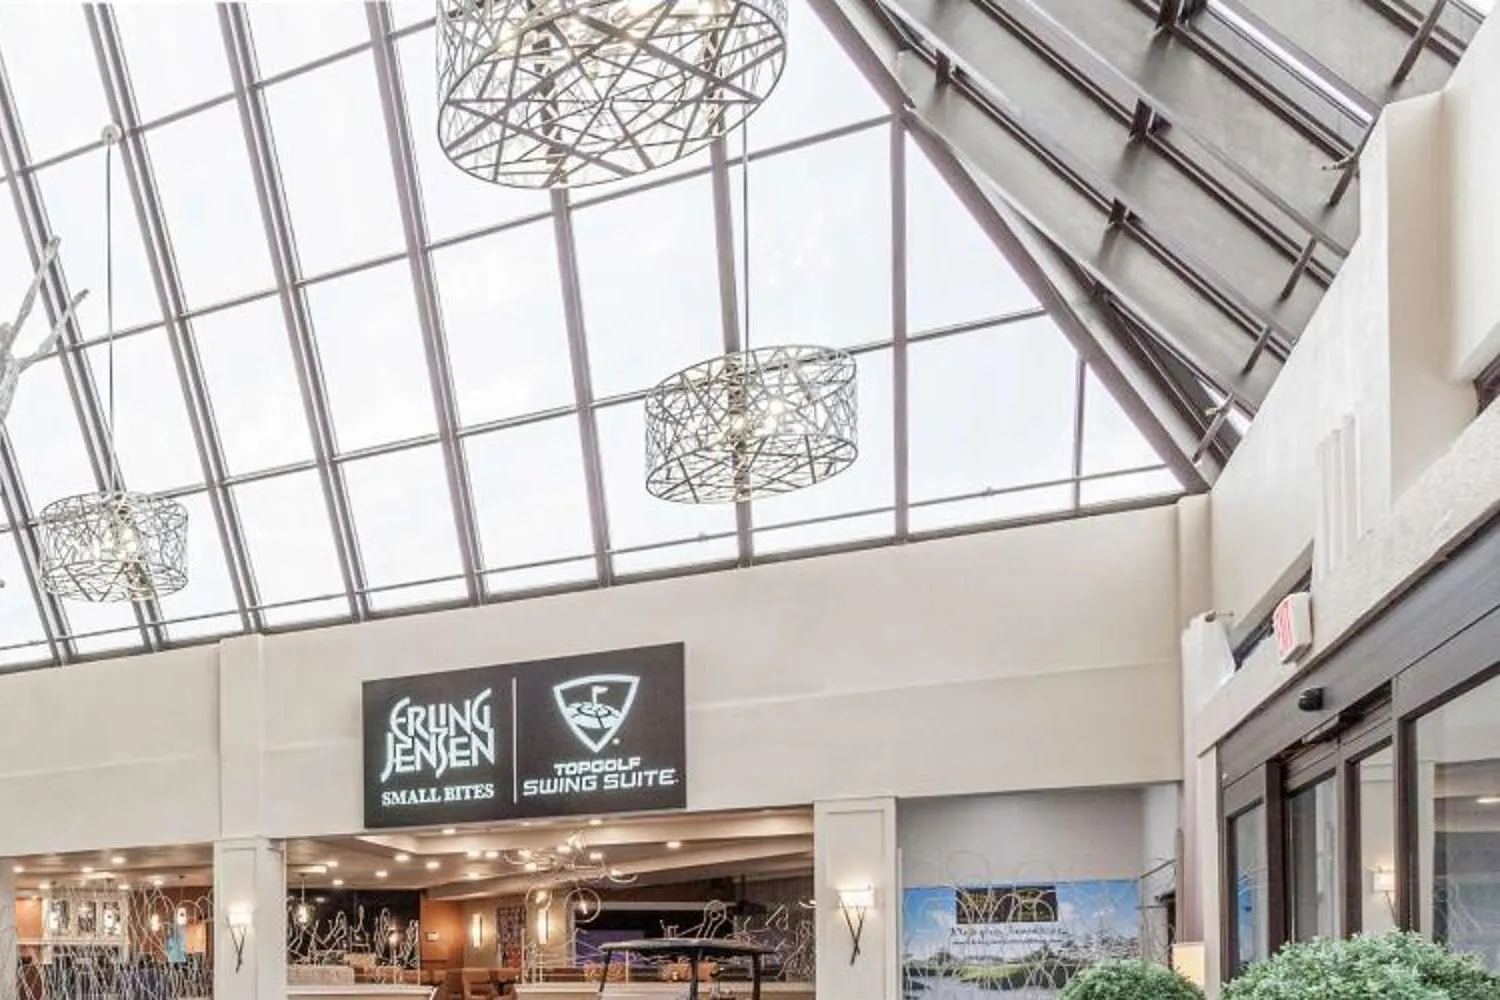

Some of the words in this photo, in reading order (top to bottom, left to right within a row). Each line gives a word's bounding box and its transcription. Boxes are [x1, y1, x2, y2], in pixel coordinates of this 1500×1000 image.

[389, 687, 493, 742] ERLING
[380, 728, 495, 783] JENSEN
[553, 756, 642, 776] TOPGOLF
[381, 787, 441, 807] SMALL
[443, 783, 495, 802] BITES
[522, 774, 597, 796] SWING
[603, 768, 677, 790] SUITE
